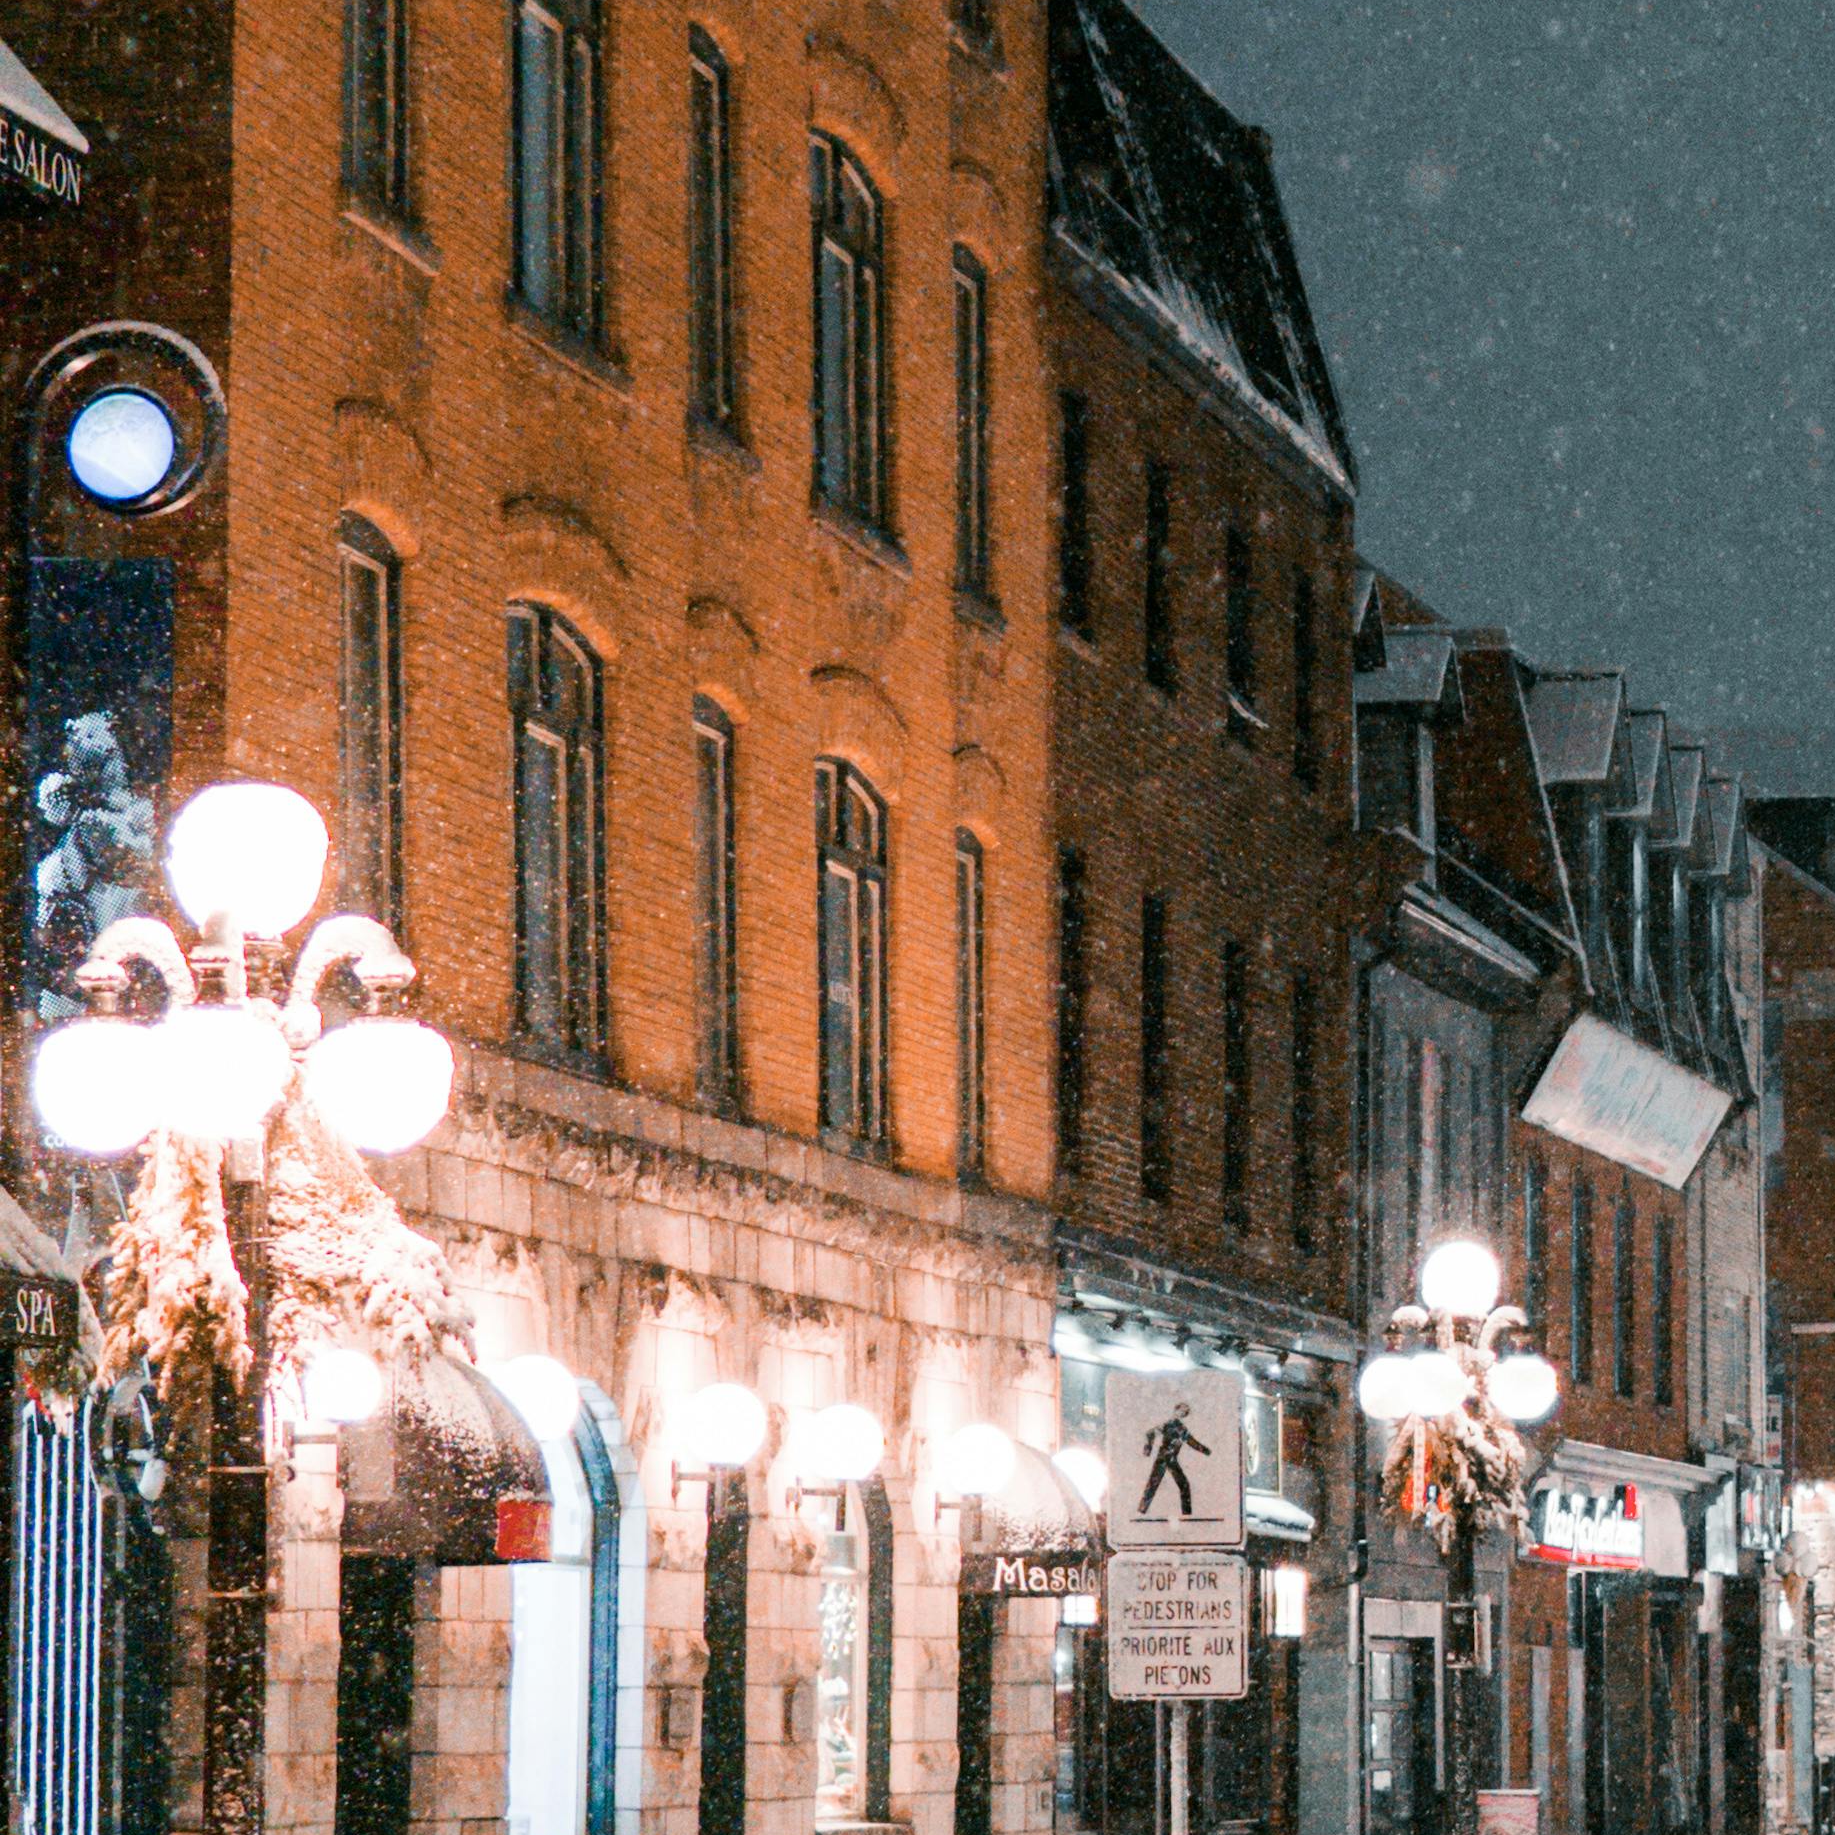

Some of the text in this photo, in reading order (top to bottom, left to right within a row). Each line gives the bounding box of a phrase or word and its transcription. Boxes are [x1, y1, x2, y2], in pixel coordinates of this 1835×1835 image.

[13, 129, 81, 205] SALON
[16, 1288, 57, 1336] SPA
[992, 1557, 1097, 1591] Masala
[1137, 1571, 1217, 1591] STOP FOR
[1123, 1599, 1232, 1620] PEDESTRIANS
[1120, 1632, 1235, 1656] PRIORITÉ AUX
